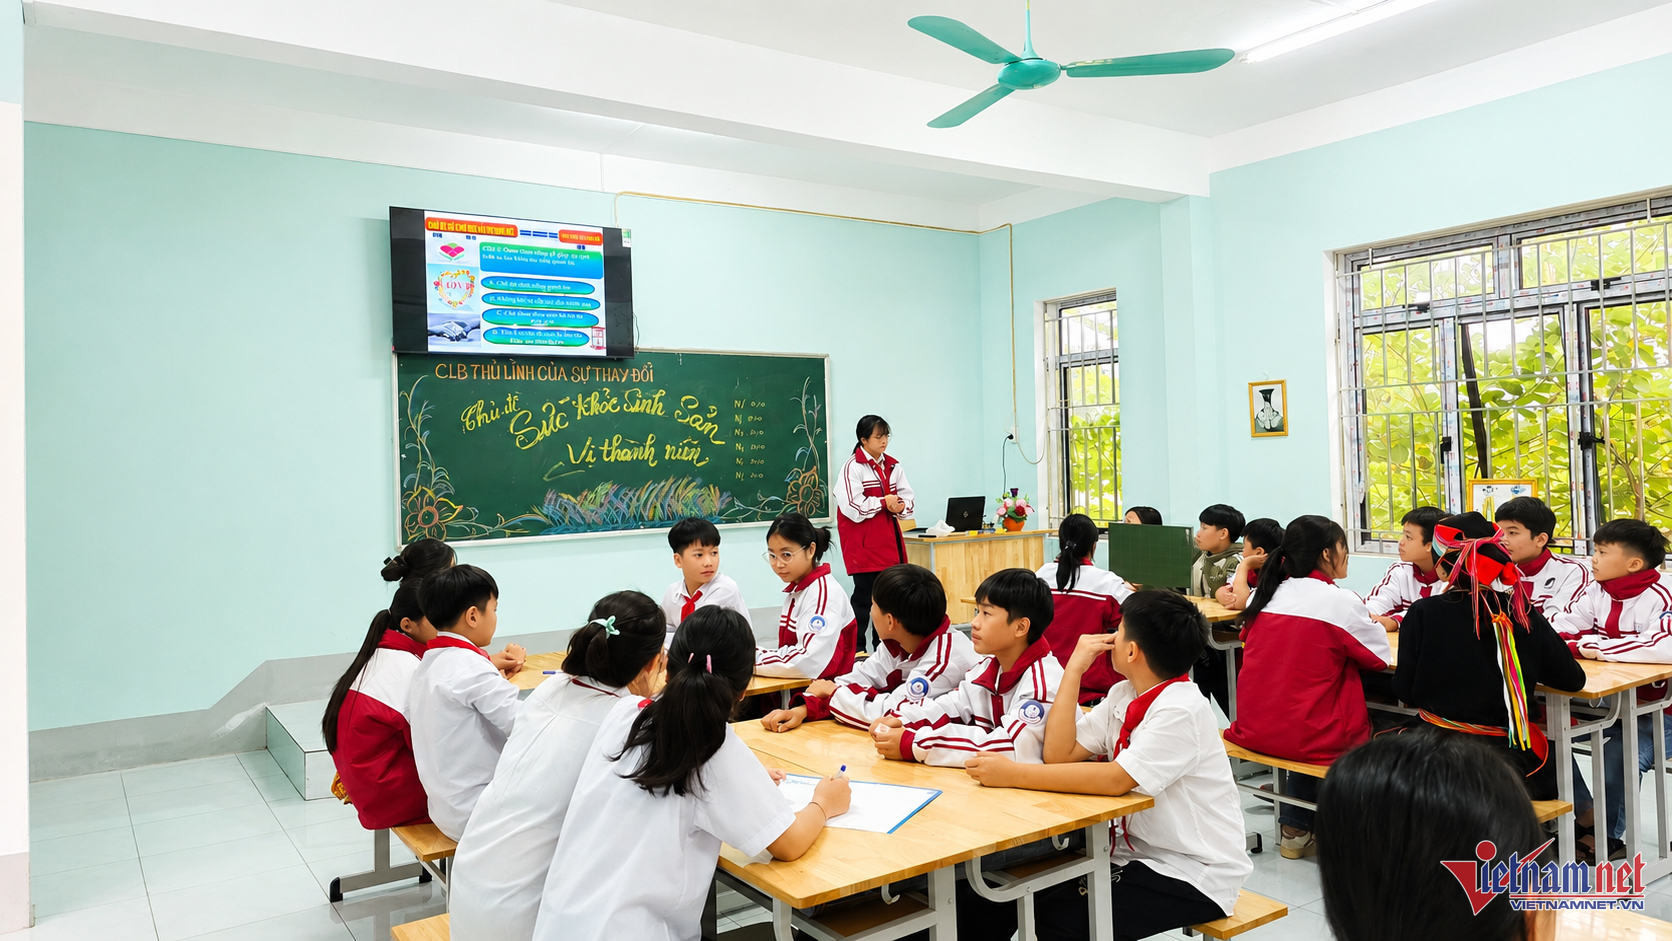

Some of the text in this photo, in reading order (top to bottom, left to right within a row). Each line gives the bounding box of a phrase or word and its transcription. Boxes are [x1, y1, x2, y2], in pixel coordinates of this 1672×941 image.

[435, 363, 468, 380] CLB
[470, 359, 500, 380] THỦ
[537, 361, 568, 381] CỦA
[570, 365, 592, 385] SỰ
[591, 367, 629, 383] THAY
[630, 361, 655, 383] ĐỔI
[623, 388, 666, 416] Sinh
[674, 395, 726, 445] Sản
[566, 436, 597, 468] Vị
[599, 433, 658, 468] thành
